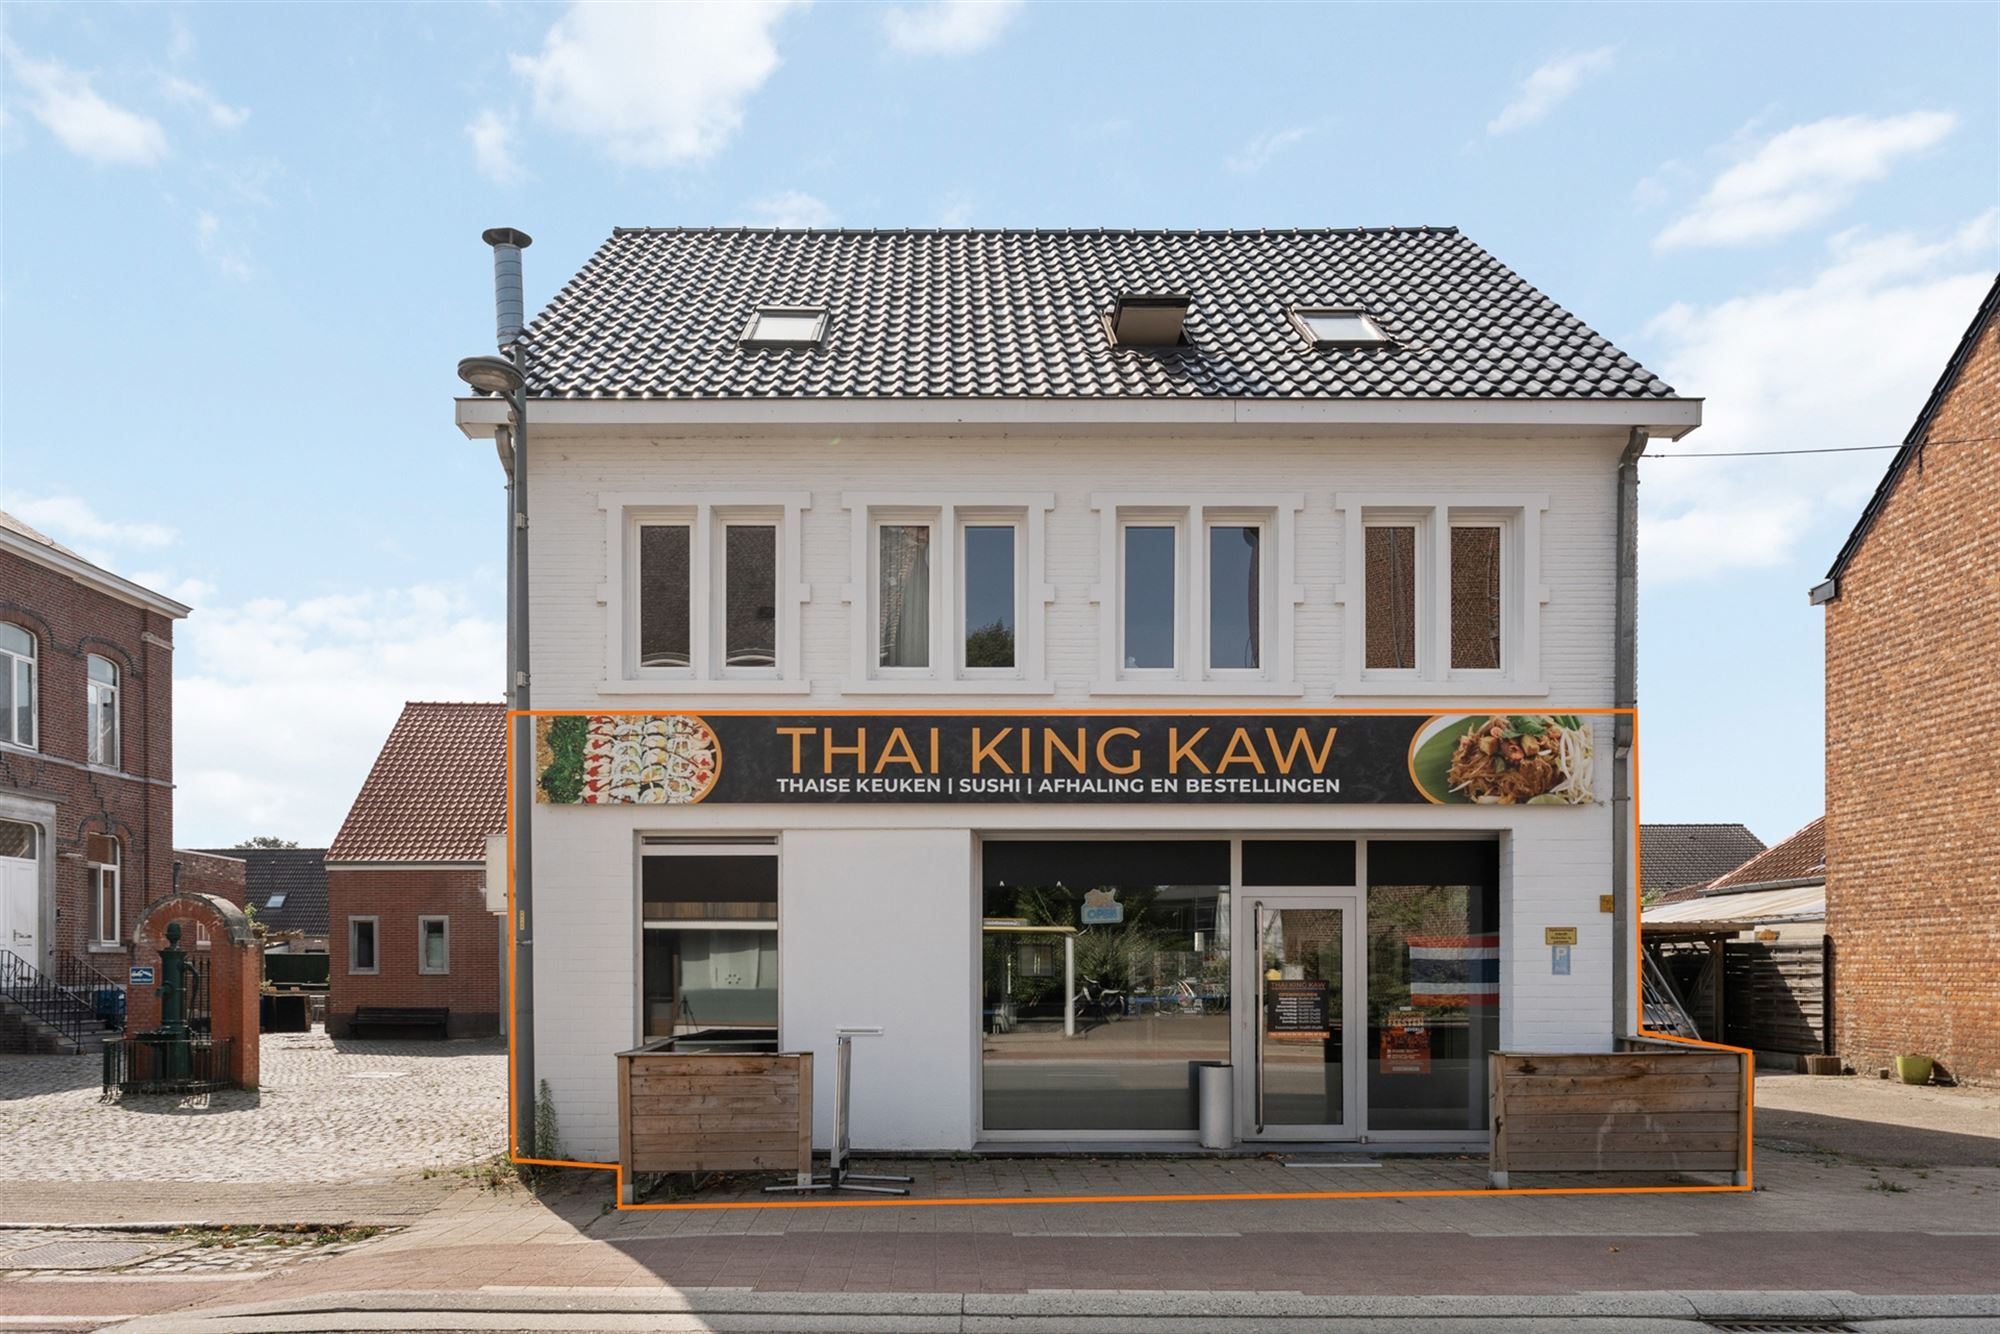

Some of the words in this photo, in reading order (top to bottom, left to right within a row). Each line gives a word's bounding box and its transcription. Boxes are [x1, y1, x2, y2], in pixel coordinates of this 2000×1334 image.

[777, 728, 938, 774] THAI
[972, 727, 1141, 774] KING
[1169, 727, 1337, 774] KAW
[777, 778, 850, 793] THAISE
[856, 778, 940, 793] KEUKEN
[959, 778, 1020, 793] SUSHI
[1038, 778, 1144, 793] AFHALING
[1151, 778, 1178, 793] EN
[1186, 778, 1340, 793] BESTELLINGEN
[1087, 908, 1117, 919] OPEN
